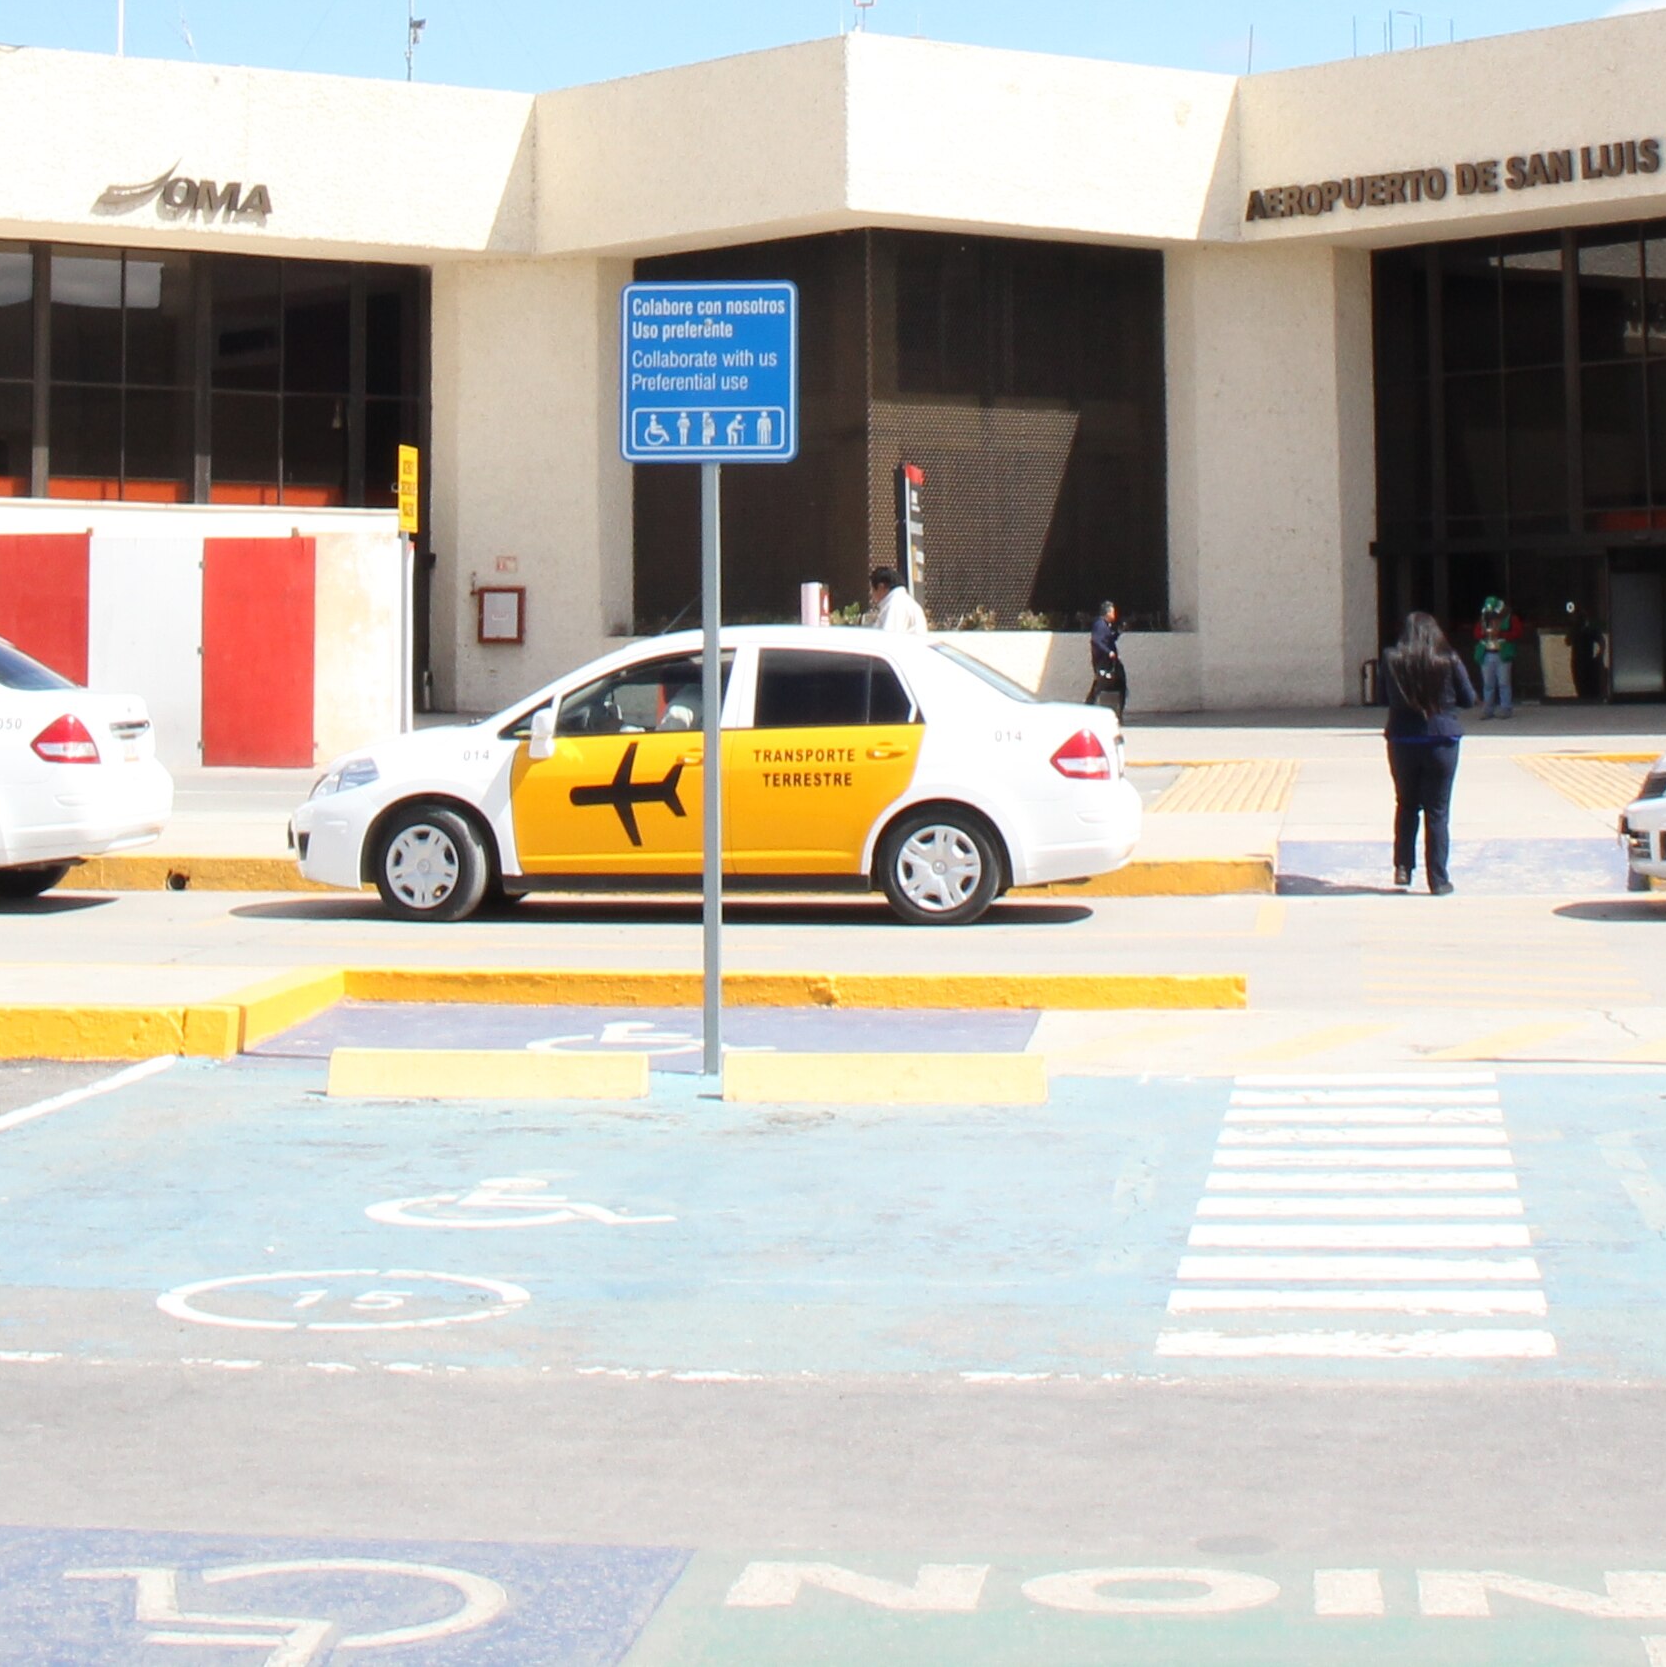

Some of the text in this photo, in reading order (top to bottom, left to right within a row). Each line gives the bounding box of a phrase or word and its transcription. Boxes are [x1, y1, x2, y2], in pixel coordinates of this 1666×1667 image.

[1245, 167, 1448, 223] AEROPUERTO
[1454, 160, 1501, 196] DE
[1505, 148, 1573, 191] SAN
[1580, 138, 1661, 181] LUIS
[163, 177, 273, 216] OMA
[633, 297, 785, 316] Colabore con nosotros
[633, 321, 733, 342] Uso preferente
[632, 349, 778, 369] Collaborate with us
[632, 373, 749, 391] Preferential use
[994, 729, 1023, 743] 014
[463, 749, 490, 761] 014
[753, 748, 856, 763] TRANSPORTE
[762, 772, 853, 788] TERRESTRE
